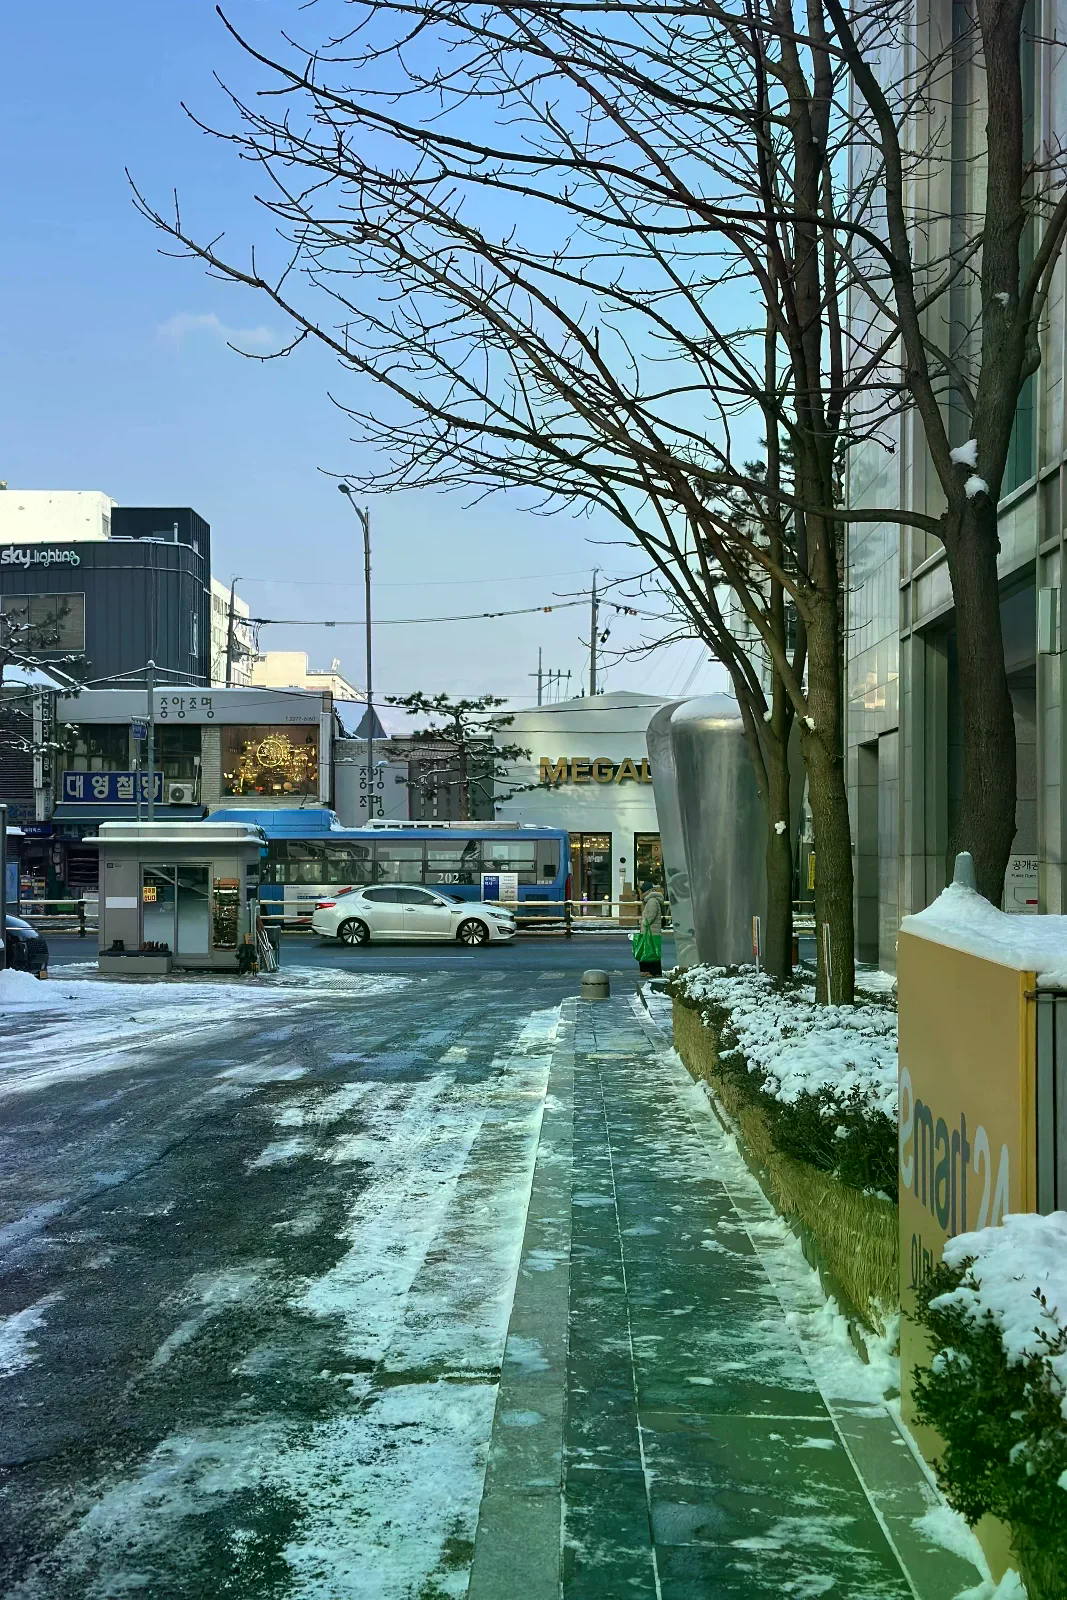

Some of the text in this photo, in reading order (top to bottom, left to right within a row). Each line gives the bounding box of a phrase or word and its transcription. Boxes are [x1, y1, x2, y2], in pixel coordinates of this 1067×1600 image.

[0, 546, 80, 569] sky lighting
[160, 697, 214, 719] 중앙조명
[539, 756, 653, 784] MEGAL
